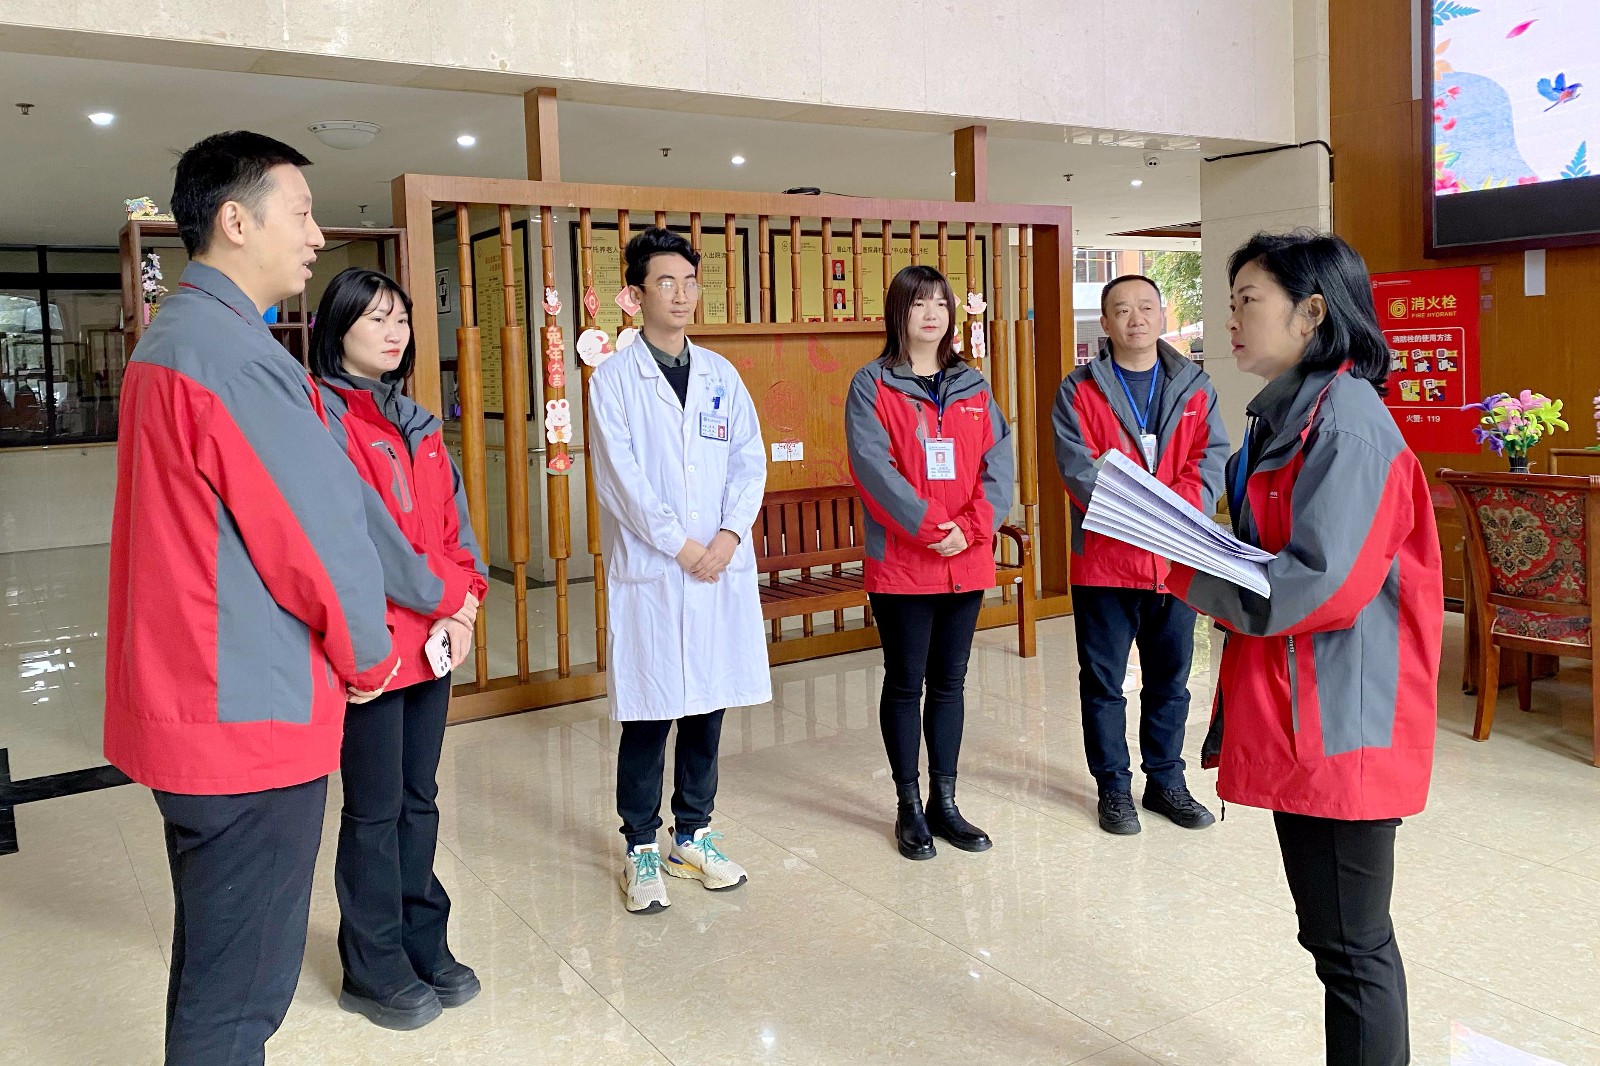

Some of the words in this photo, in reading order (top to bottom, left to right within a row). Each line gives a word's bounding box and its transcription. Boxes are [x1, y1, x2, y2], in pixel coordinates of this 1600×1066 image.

[1411, 294, 1457, 311] 消火栓
[1392, 333, 1453, 344] 消防栓的使用方法
[546, 327, 564, 386] 兔年大吉
